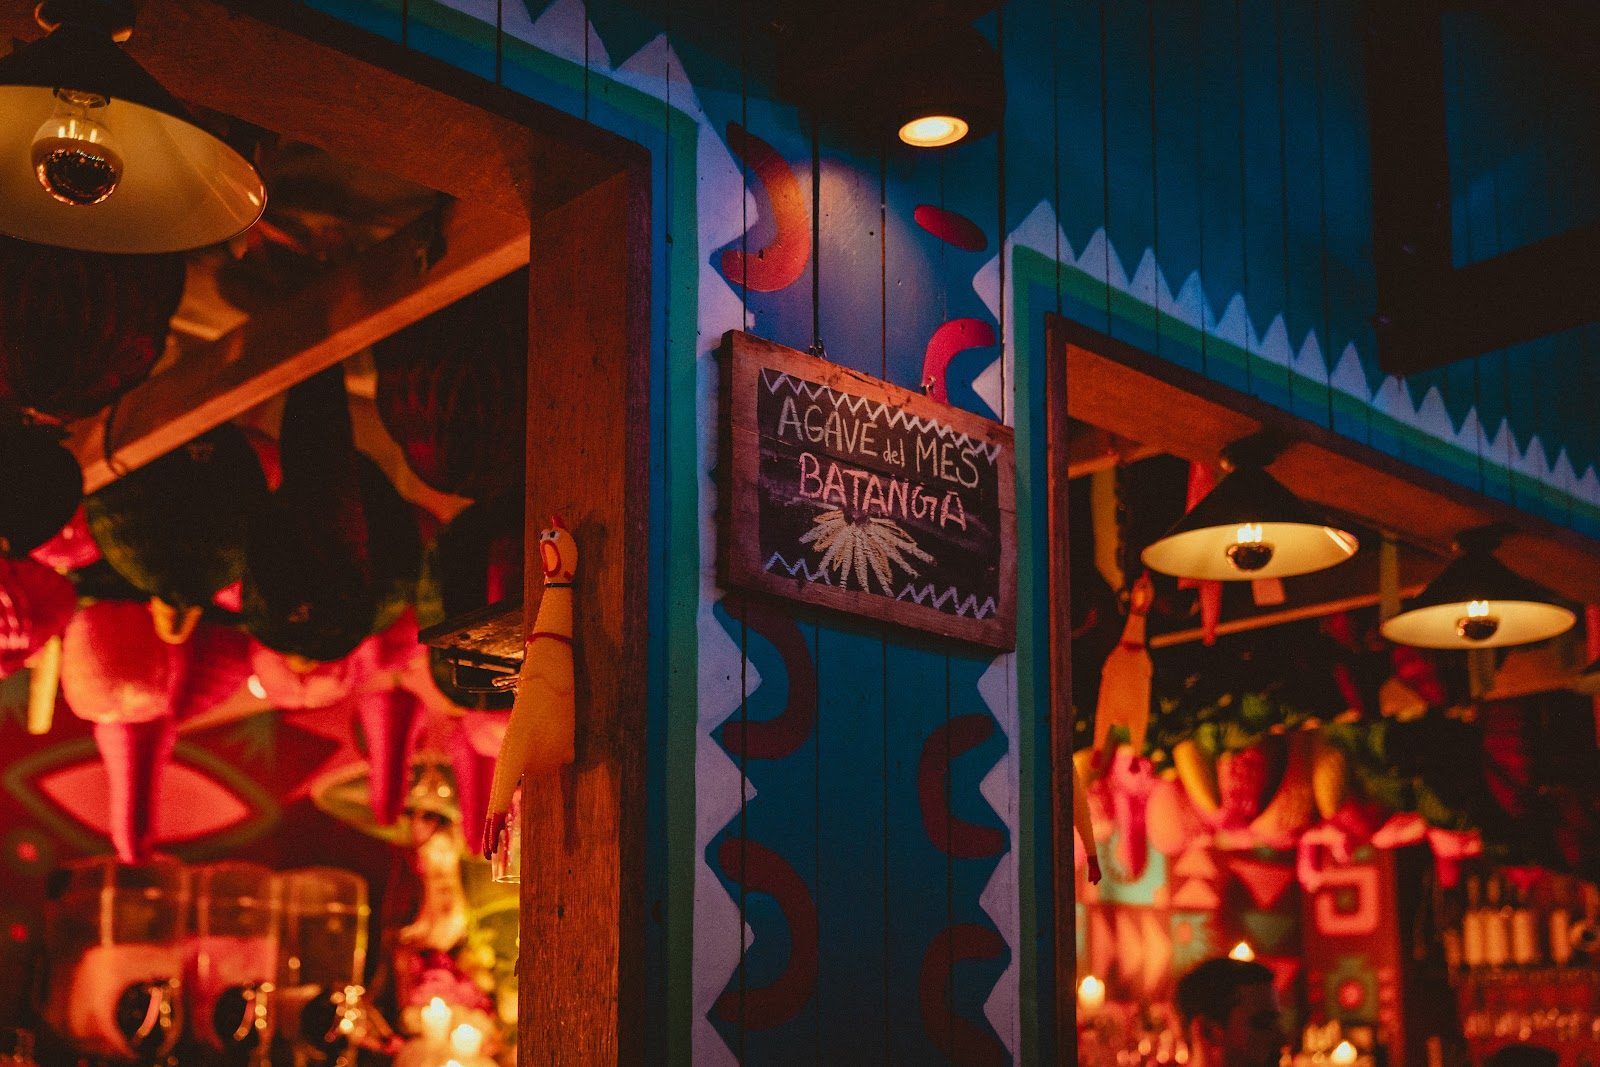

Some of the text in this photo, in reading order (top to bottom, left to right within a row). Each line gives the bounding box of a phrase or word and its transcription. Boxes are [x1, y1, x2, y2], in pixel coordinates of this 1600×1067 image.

[778, 397, 979, 488] AGAVE del MES
[799, 452, 967, 531] BATANGA
